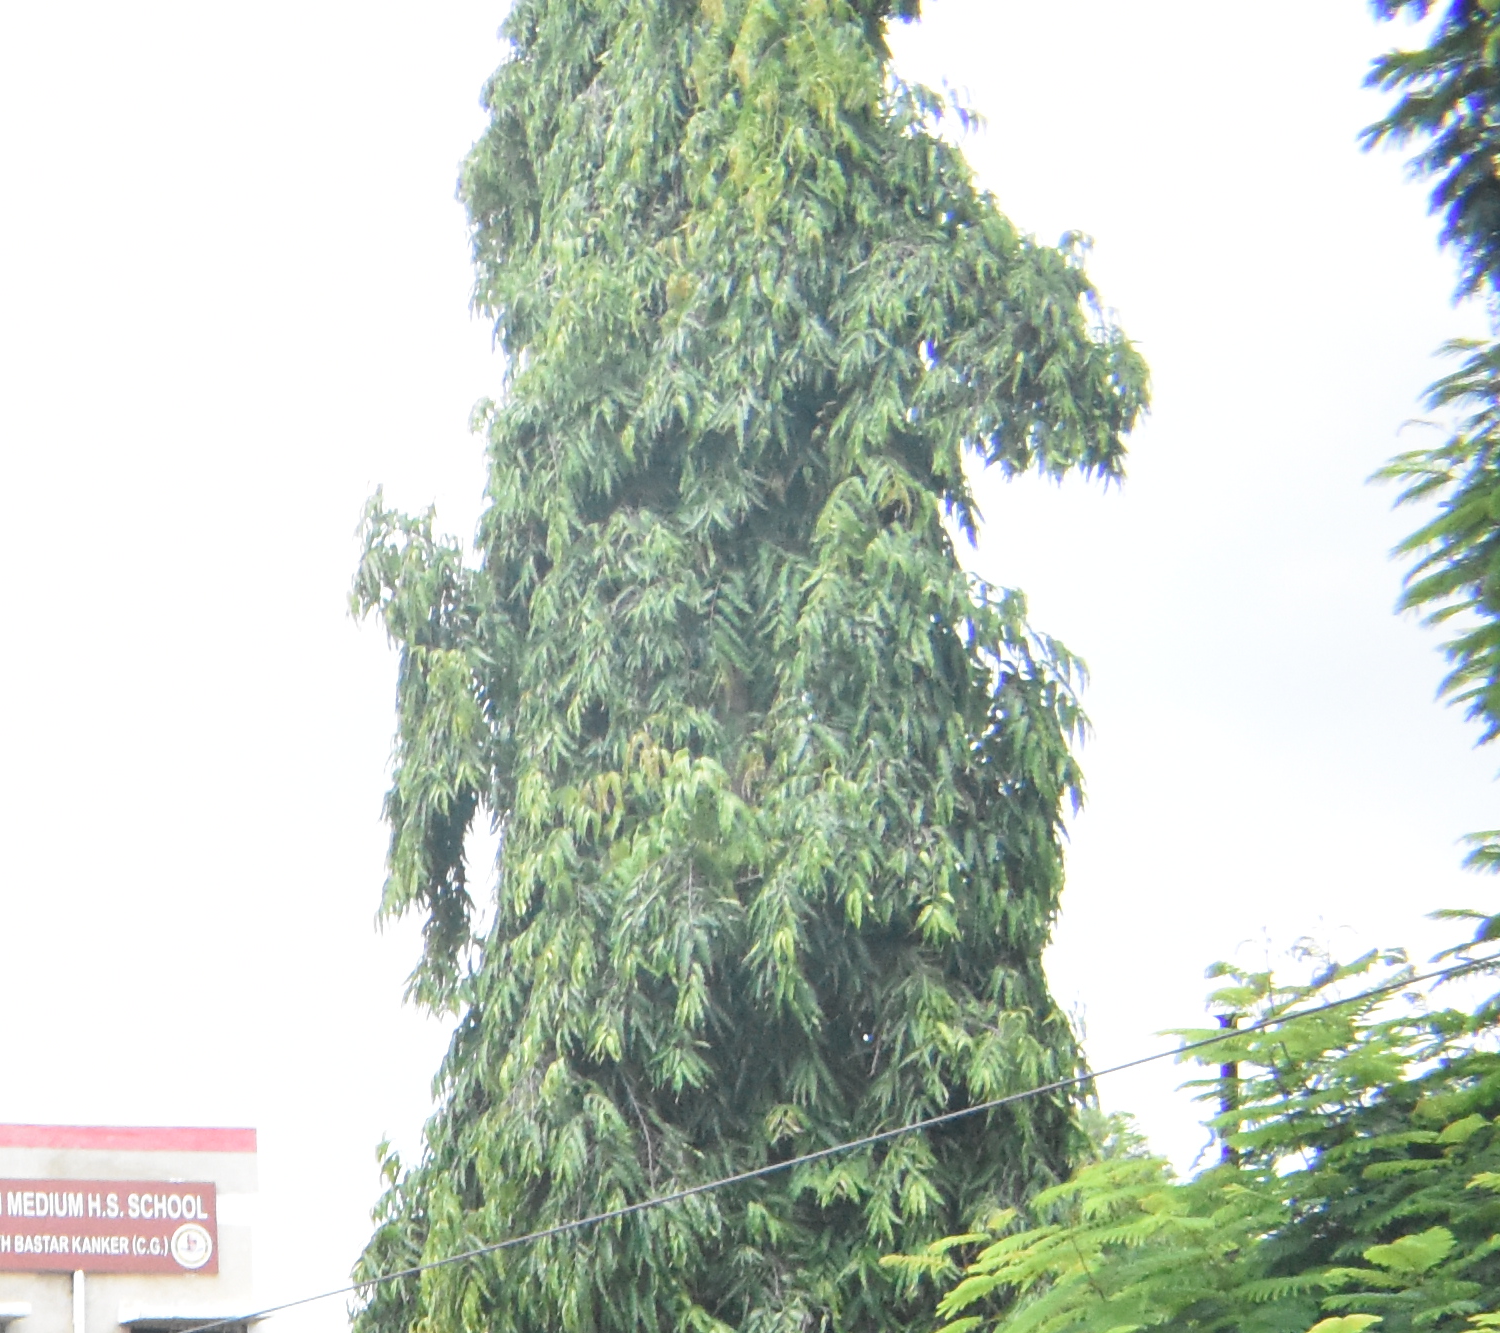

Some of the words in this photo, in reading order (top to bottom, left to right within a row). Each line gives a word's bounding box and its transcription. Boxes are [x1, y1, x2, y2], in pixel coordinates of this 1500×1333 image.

[7, 1192, 84, 1218] MEDIUM
[88, 1193, 124, 1218] H.S.
[128, 1194, 208, 1220] SCHOOL
[14, 1236, 69, 1255] BASTAR
[71, 1237, 129, 1255] KANKER
[132, 1237, 169, 1256] (C.G.)
